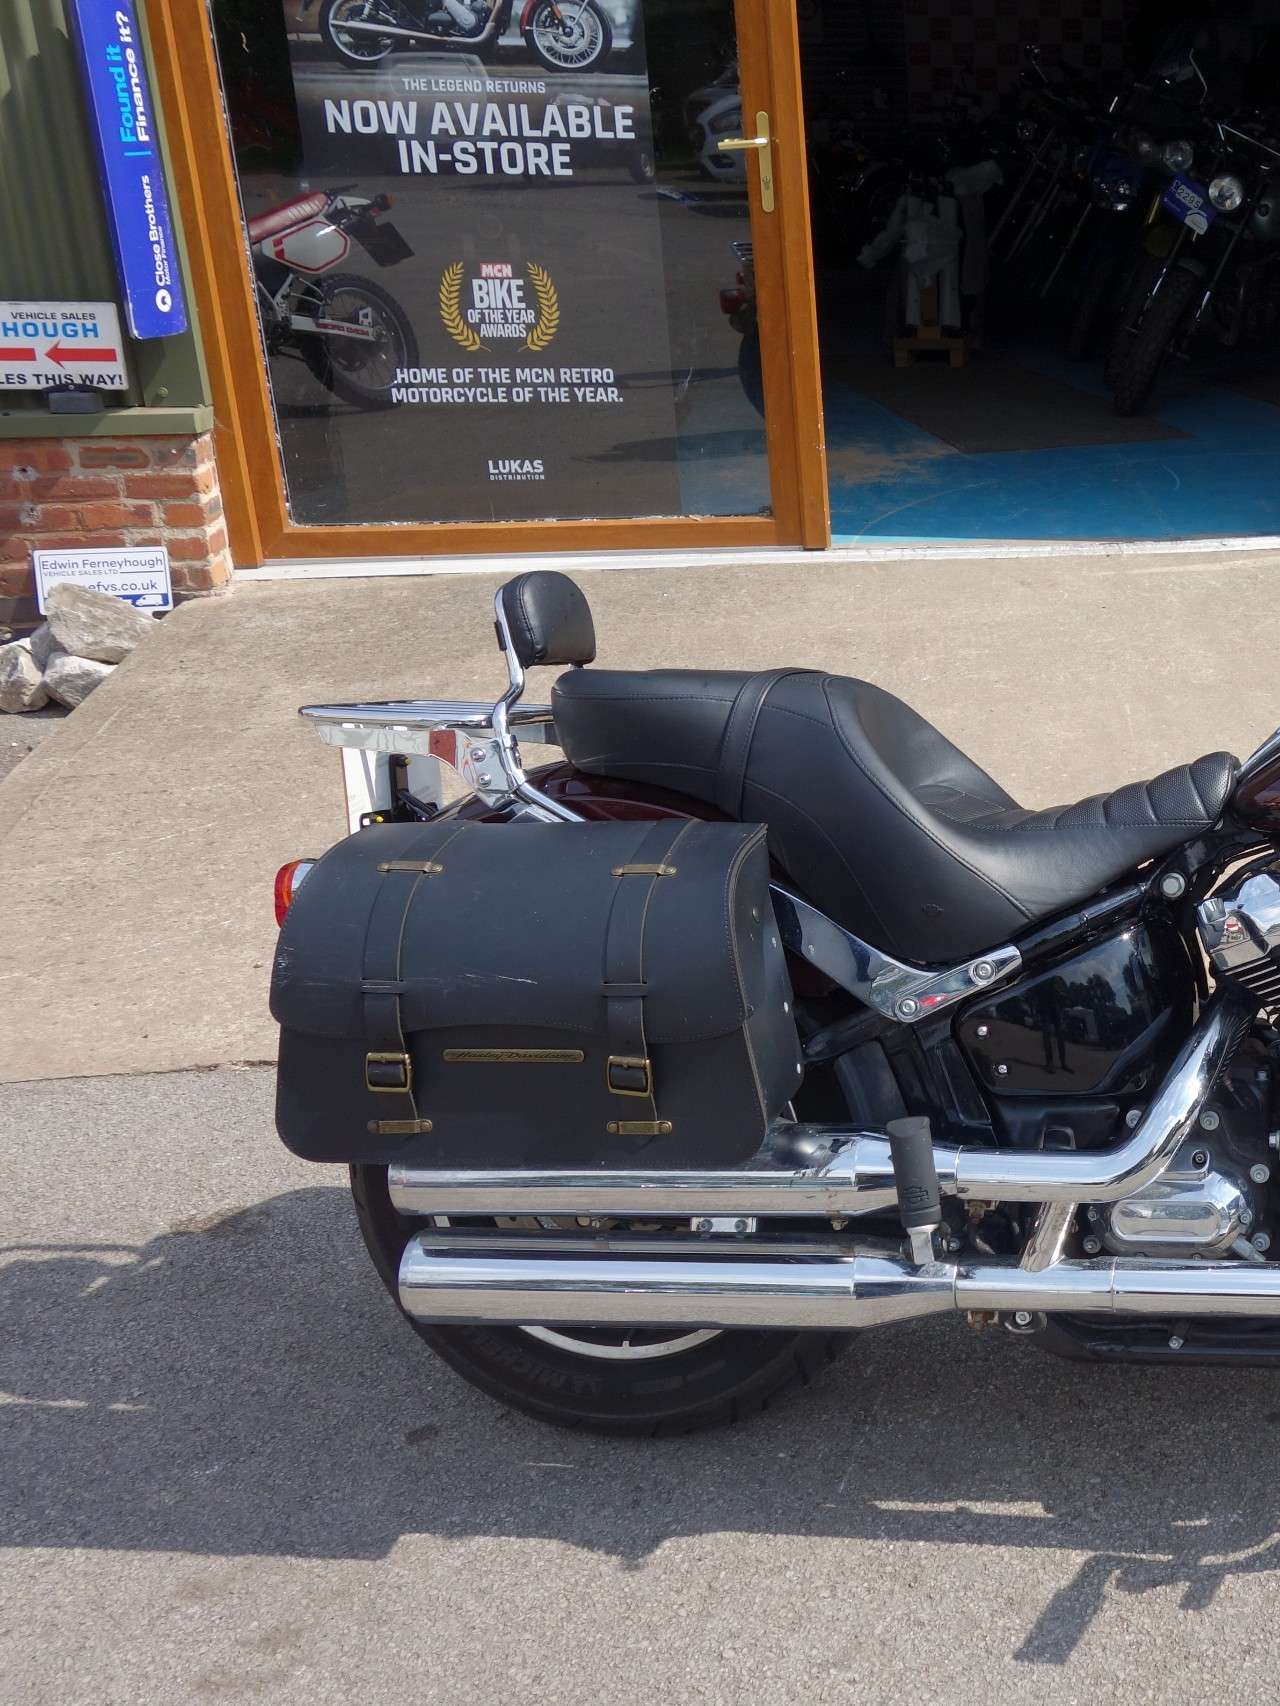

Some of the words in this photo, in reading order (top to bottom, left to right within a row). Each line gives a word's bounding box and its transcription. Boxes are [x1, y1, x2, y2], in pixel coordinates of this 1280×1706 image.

[115, 11, 133, 42] it?
[106, 44, 122, 61] it
[125, 48, 149, 141] Finance
[402, 78, 428, 92] THE
[430, 79, 483, 93] LEGEND
[485, 80, 546, 95] RETURNS
[108, 67, 138, 142] Found
[324, 99, 417, 134] NOW
[431, 102, 636, 140] AVAILABLE
[398, 140, 574, 176] IN-STORE
[141, 175, 159, 241] Brothers
[153, 243, 166, 286] Close
[481, 264, 513, 277] MCN
[472, 279, 526, 309] BIKE
[11, 312, 57, 320] VEHICLE
[467, 309, 482, 323] OF
[483, 310, 506, 323] THE
[506, 310, 535, 324] YEAR
[2, 322, 99, 338] HOUGH
[480, 324, 527, 338] AWARDS
[32, 374, 74, 385] THIS
[79, 374, 124, 386] WAY!
[396, 368, 447, 383] HOME
[452, 368, 474, 383] OF
[478, 368, 511, 383] THE
[516, 368, 555, 383] MCN
[560, 368, 614, 383] RETRO
[391, 387, 508, 402] MOTORCYCLE
[512, 387, 533, 402] OF
[538, 388, 570, 403] THE
[574, 388, 624, 403] YEAR.
[488, 460, 544, 474] LUKAS
[42, 559, 79, 570] Edwin
[82, 557, 163, 570] Ferneyhough
